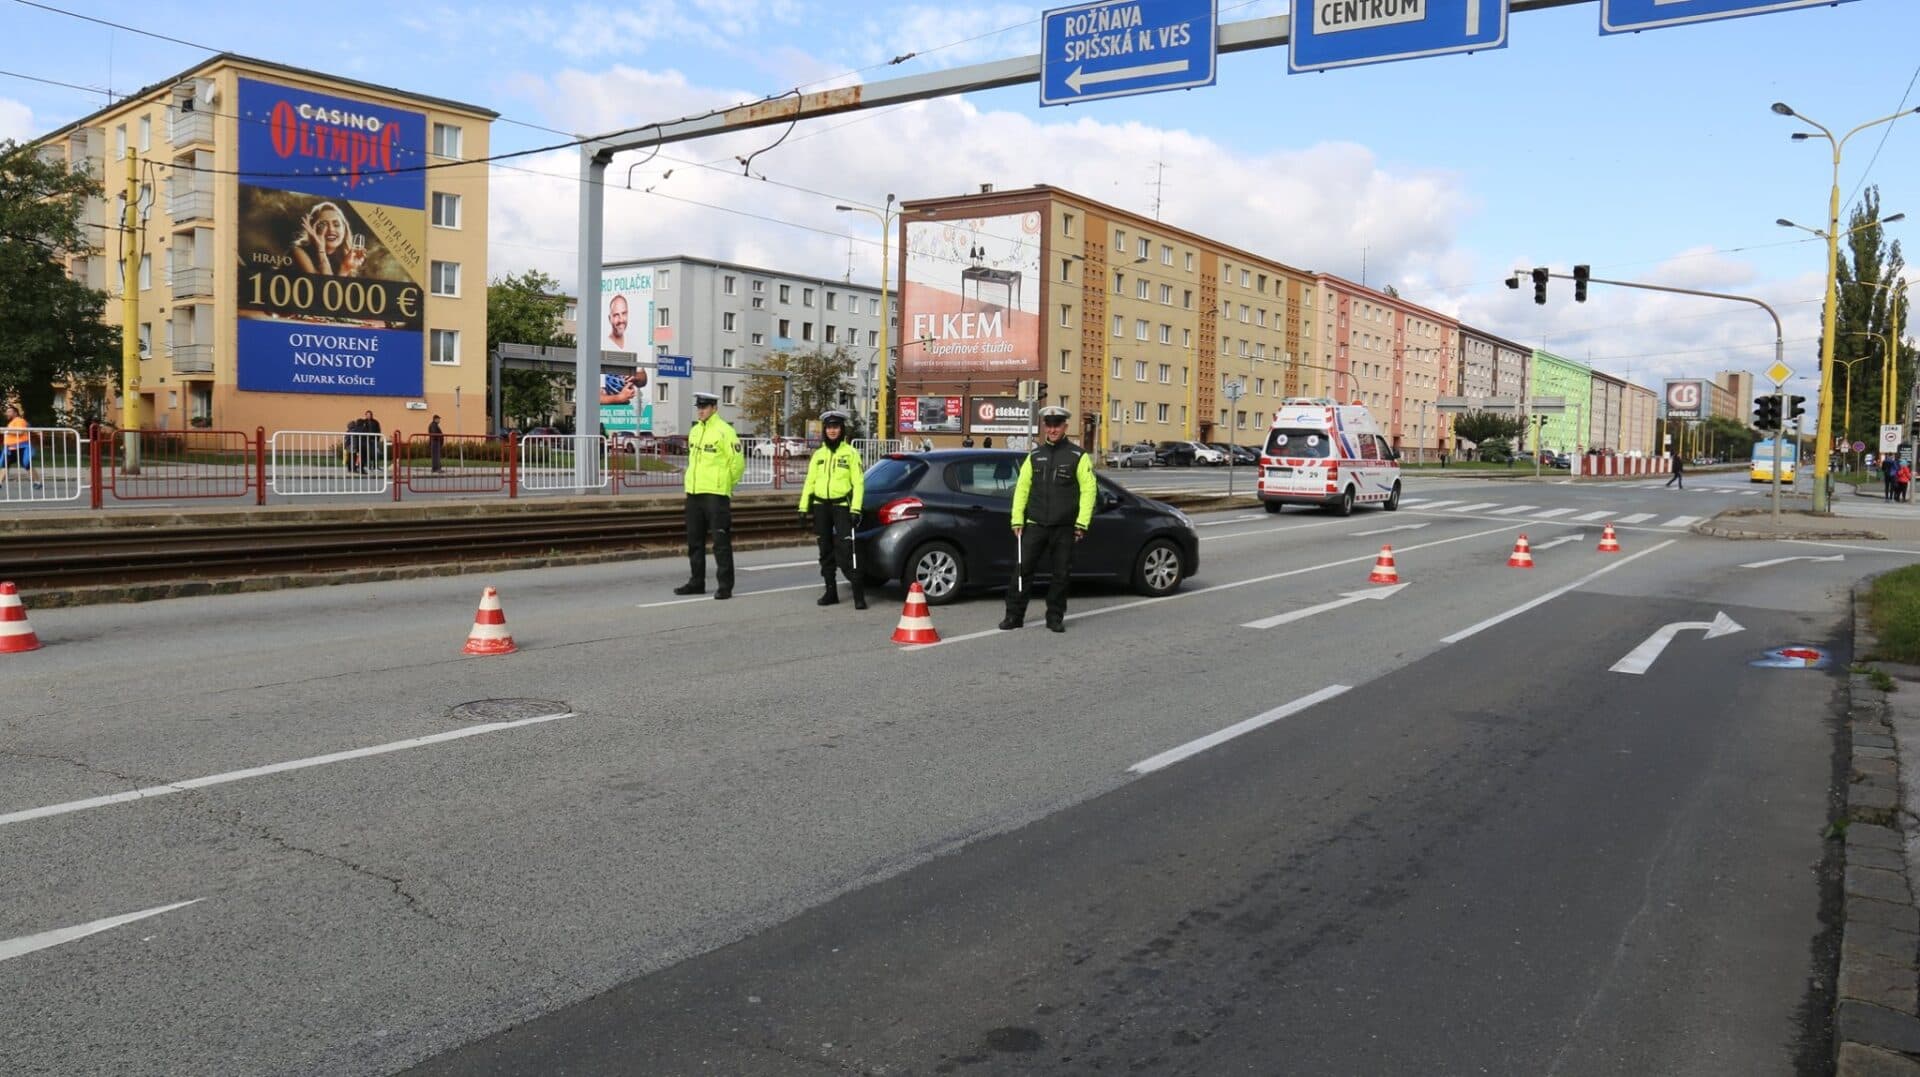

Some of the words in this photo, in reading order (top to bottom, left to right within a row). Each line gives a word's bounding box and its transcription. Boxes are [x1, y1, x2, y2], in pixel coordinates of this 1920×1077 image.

[1065, 6, 1142, 37] ROŽŇAVA
[1321, 0, 1418, 26] CENTRUM
[1064, 28, 1133, 62] SPIŠSKÁ
[1139, 29, 1154, 51] N.
[1159, 23, 1190, 48] VES
[299, 103, 381, 132] CASINO
[372, 206, 402, 240] SUPER
[400, 239, 421, 265] HRA
[249, 272, 314, 309] 100
[322, 279, 387, 315] 000
[396, 287, 418, 317] €
[614, 274, 651, 291] POLAČEK
[913, 311, 1003, 340] ELKEM
[289, 333, 378, 351] OTVORENÉ
[932, 342, 977, 357] úpeľňové
[294, 352, 375, 369] NONSTOP
[1671, 384, 1697, 407] CB
